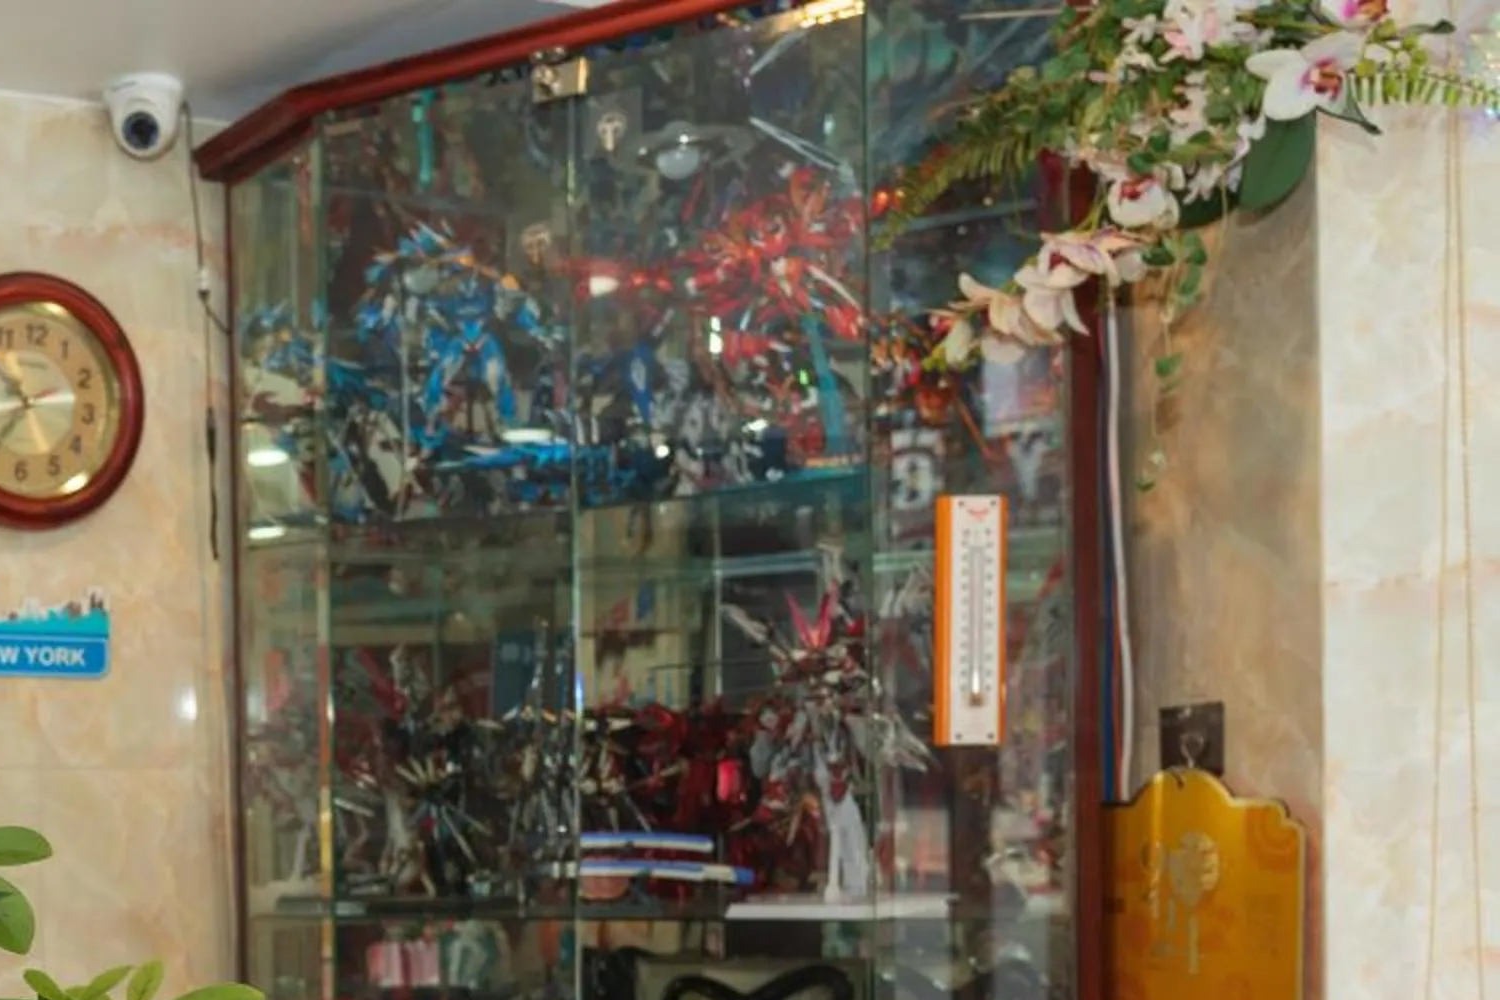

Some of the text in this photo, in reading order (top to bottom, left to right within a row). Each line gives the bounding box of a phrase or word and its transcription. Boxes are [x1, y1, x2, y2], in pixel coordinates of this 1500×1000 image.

[26, 323, 49, 346] 12
[61, 340, 69, 359] 1
[77, 368, 92, 390] 2
[81, 403, 95, 425] 3
[69, 435, 82, 456] 4
[14, 460, 28, 482] 6
[48, 454, 62, 476] 5
[24, 646, 86, 667] YORK
